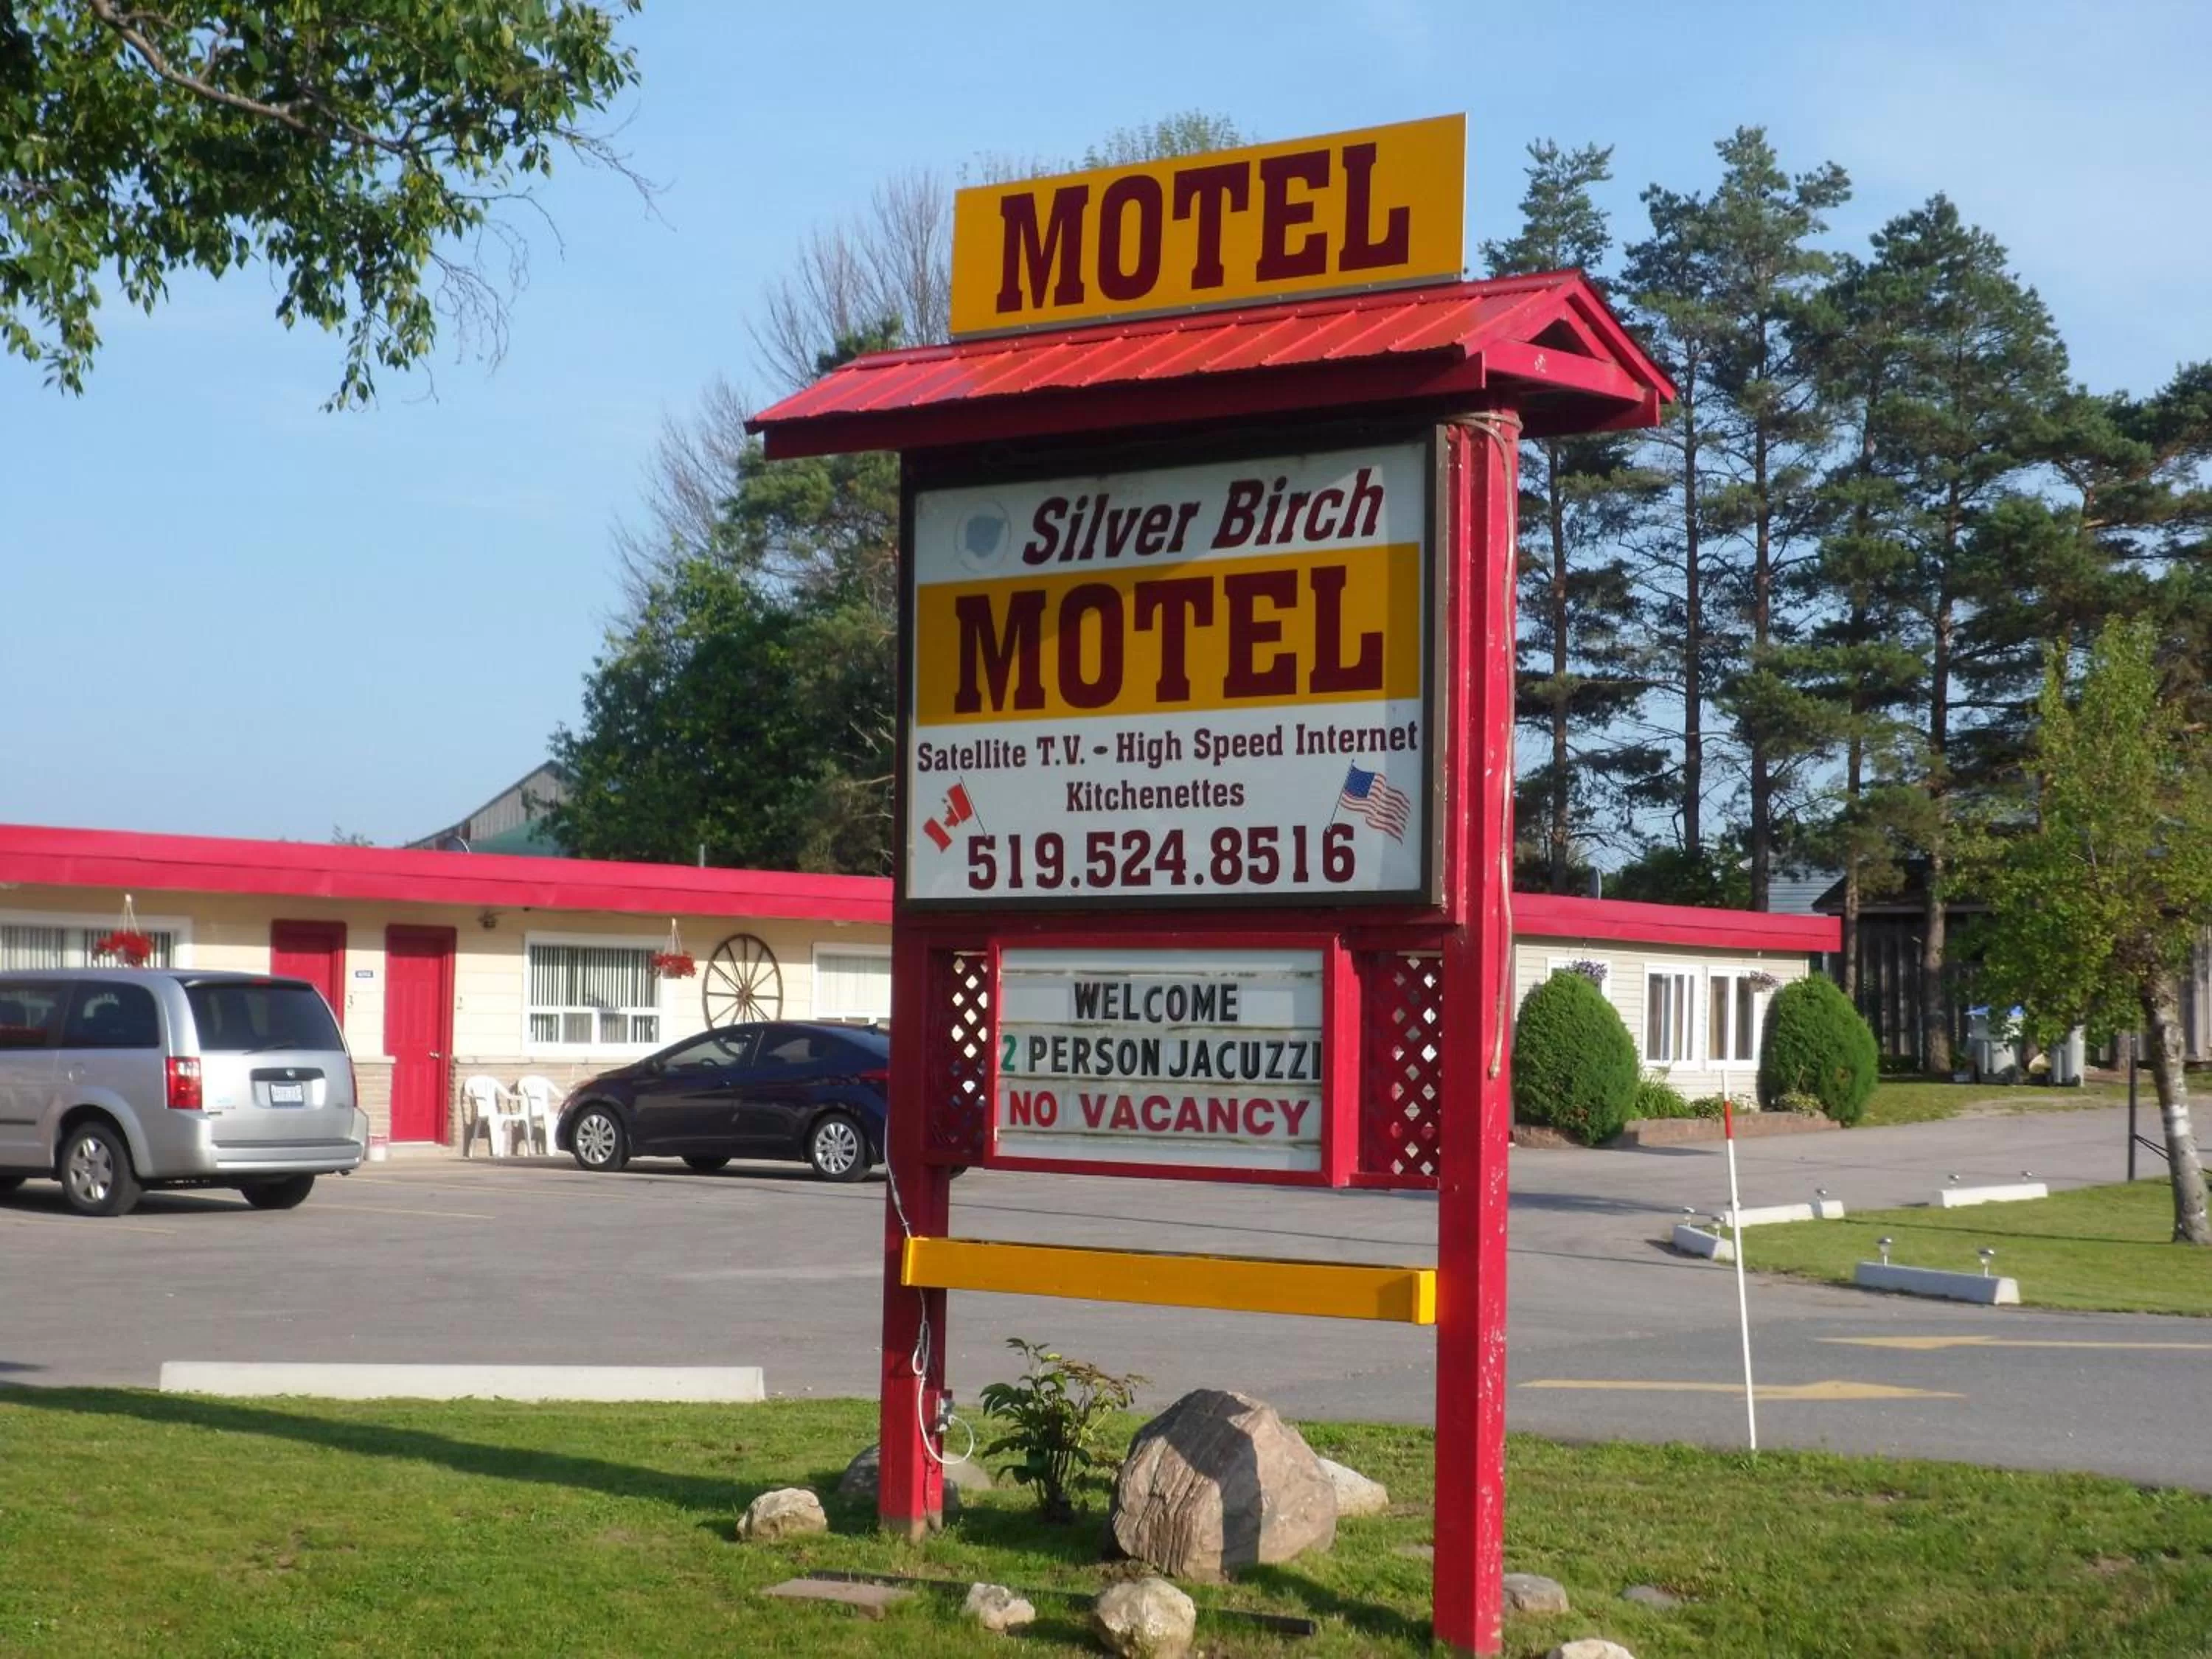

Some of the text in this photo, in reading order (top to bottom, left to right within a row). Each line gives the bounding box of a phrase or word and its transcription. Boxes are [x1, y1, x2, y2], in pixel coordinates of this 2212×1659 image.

[996, 142, 1410, 313] MOTEL
[1022, 467, 1385, 566] Silver Birch
[954, 565, 1383, 714] MOTEL
[917, 738, 1027, 772] Satellite
[1037, 734, 1085, 766] T.V.
[1116, 730, 1182, 769] High
[1194, 725, 1283, 765] Speed
[1295, 720, 1418, 755] Internet
[1066, 779, 1245, 812] Kitchenettes
[967, 822, 1355, 890] 519.524.8516
[1074, 982, 1239, 1023] WELCOME
[1001, 1034, 1018, 1071] 2
[1029, 1035, 1160, 1076] PERSON
[1009, 1091, 1311, 1136] NO VACANCY
